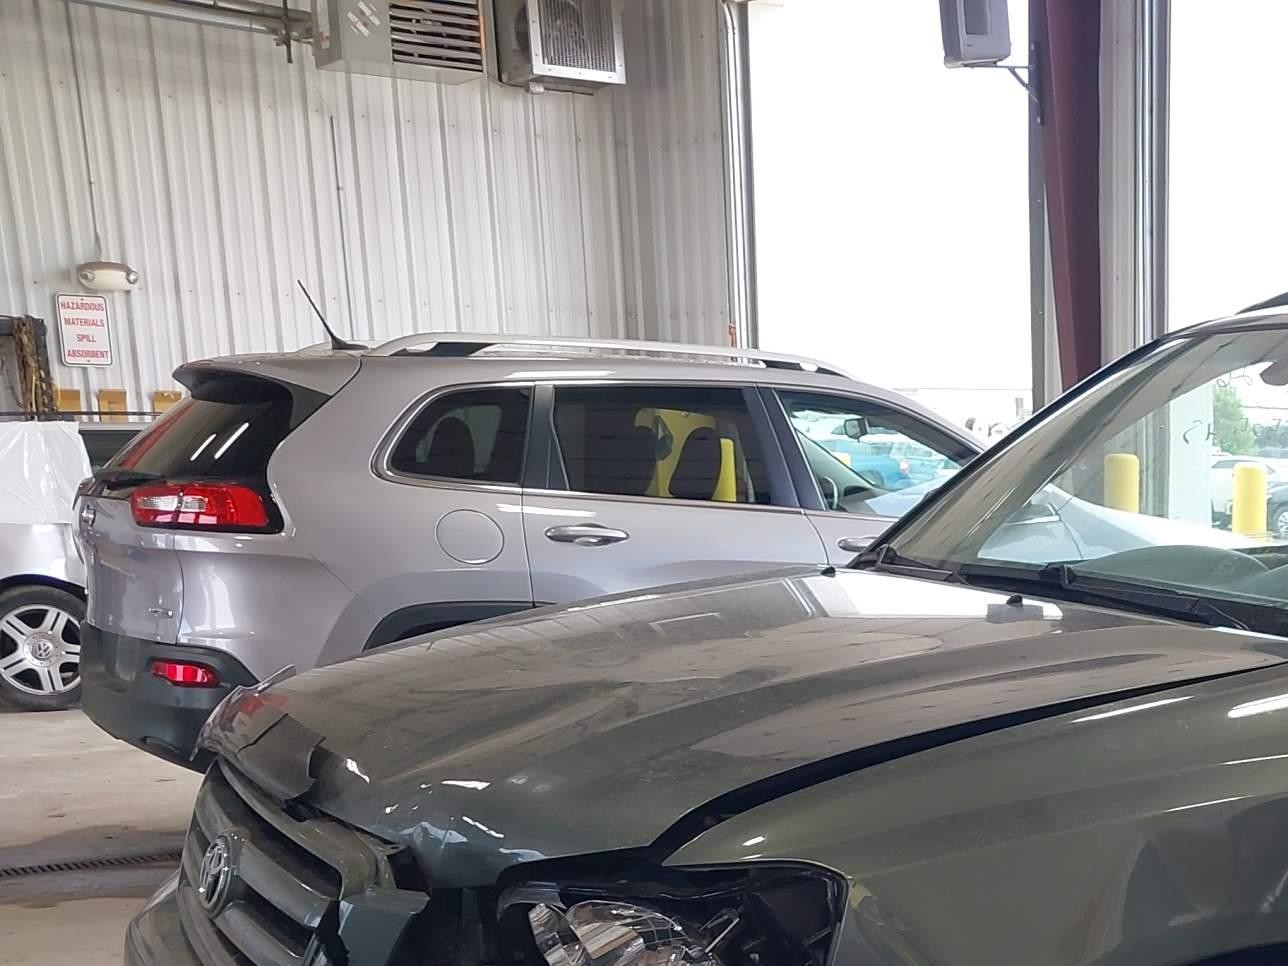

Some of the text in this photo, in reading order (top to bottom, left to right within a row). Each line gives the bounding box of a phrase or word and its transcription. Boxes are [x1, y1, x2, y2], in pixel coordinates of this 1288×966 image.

[61, 301, 105, 312] HAZARDOUS
[64, 317, 105, 328] MATERIALS
[76, 333, 97, 343] SPILL
[67, 349, 109, 359] ABSORBENT
